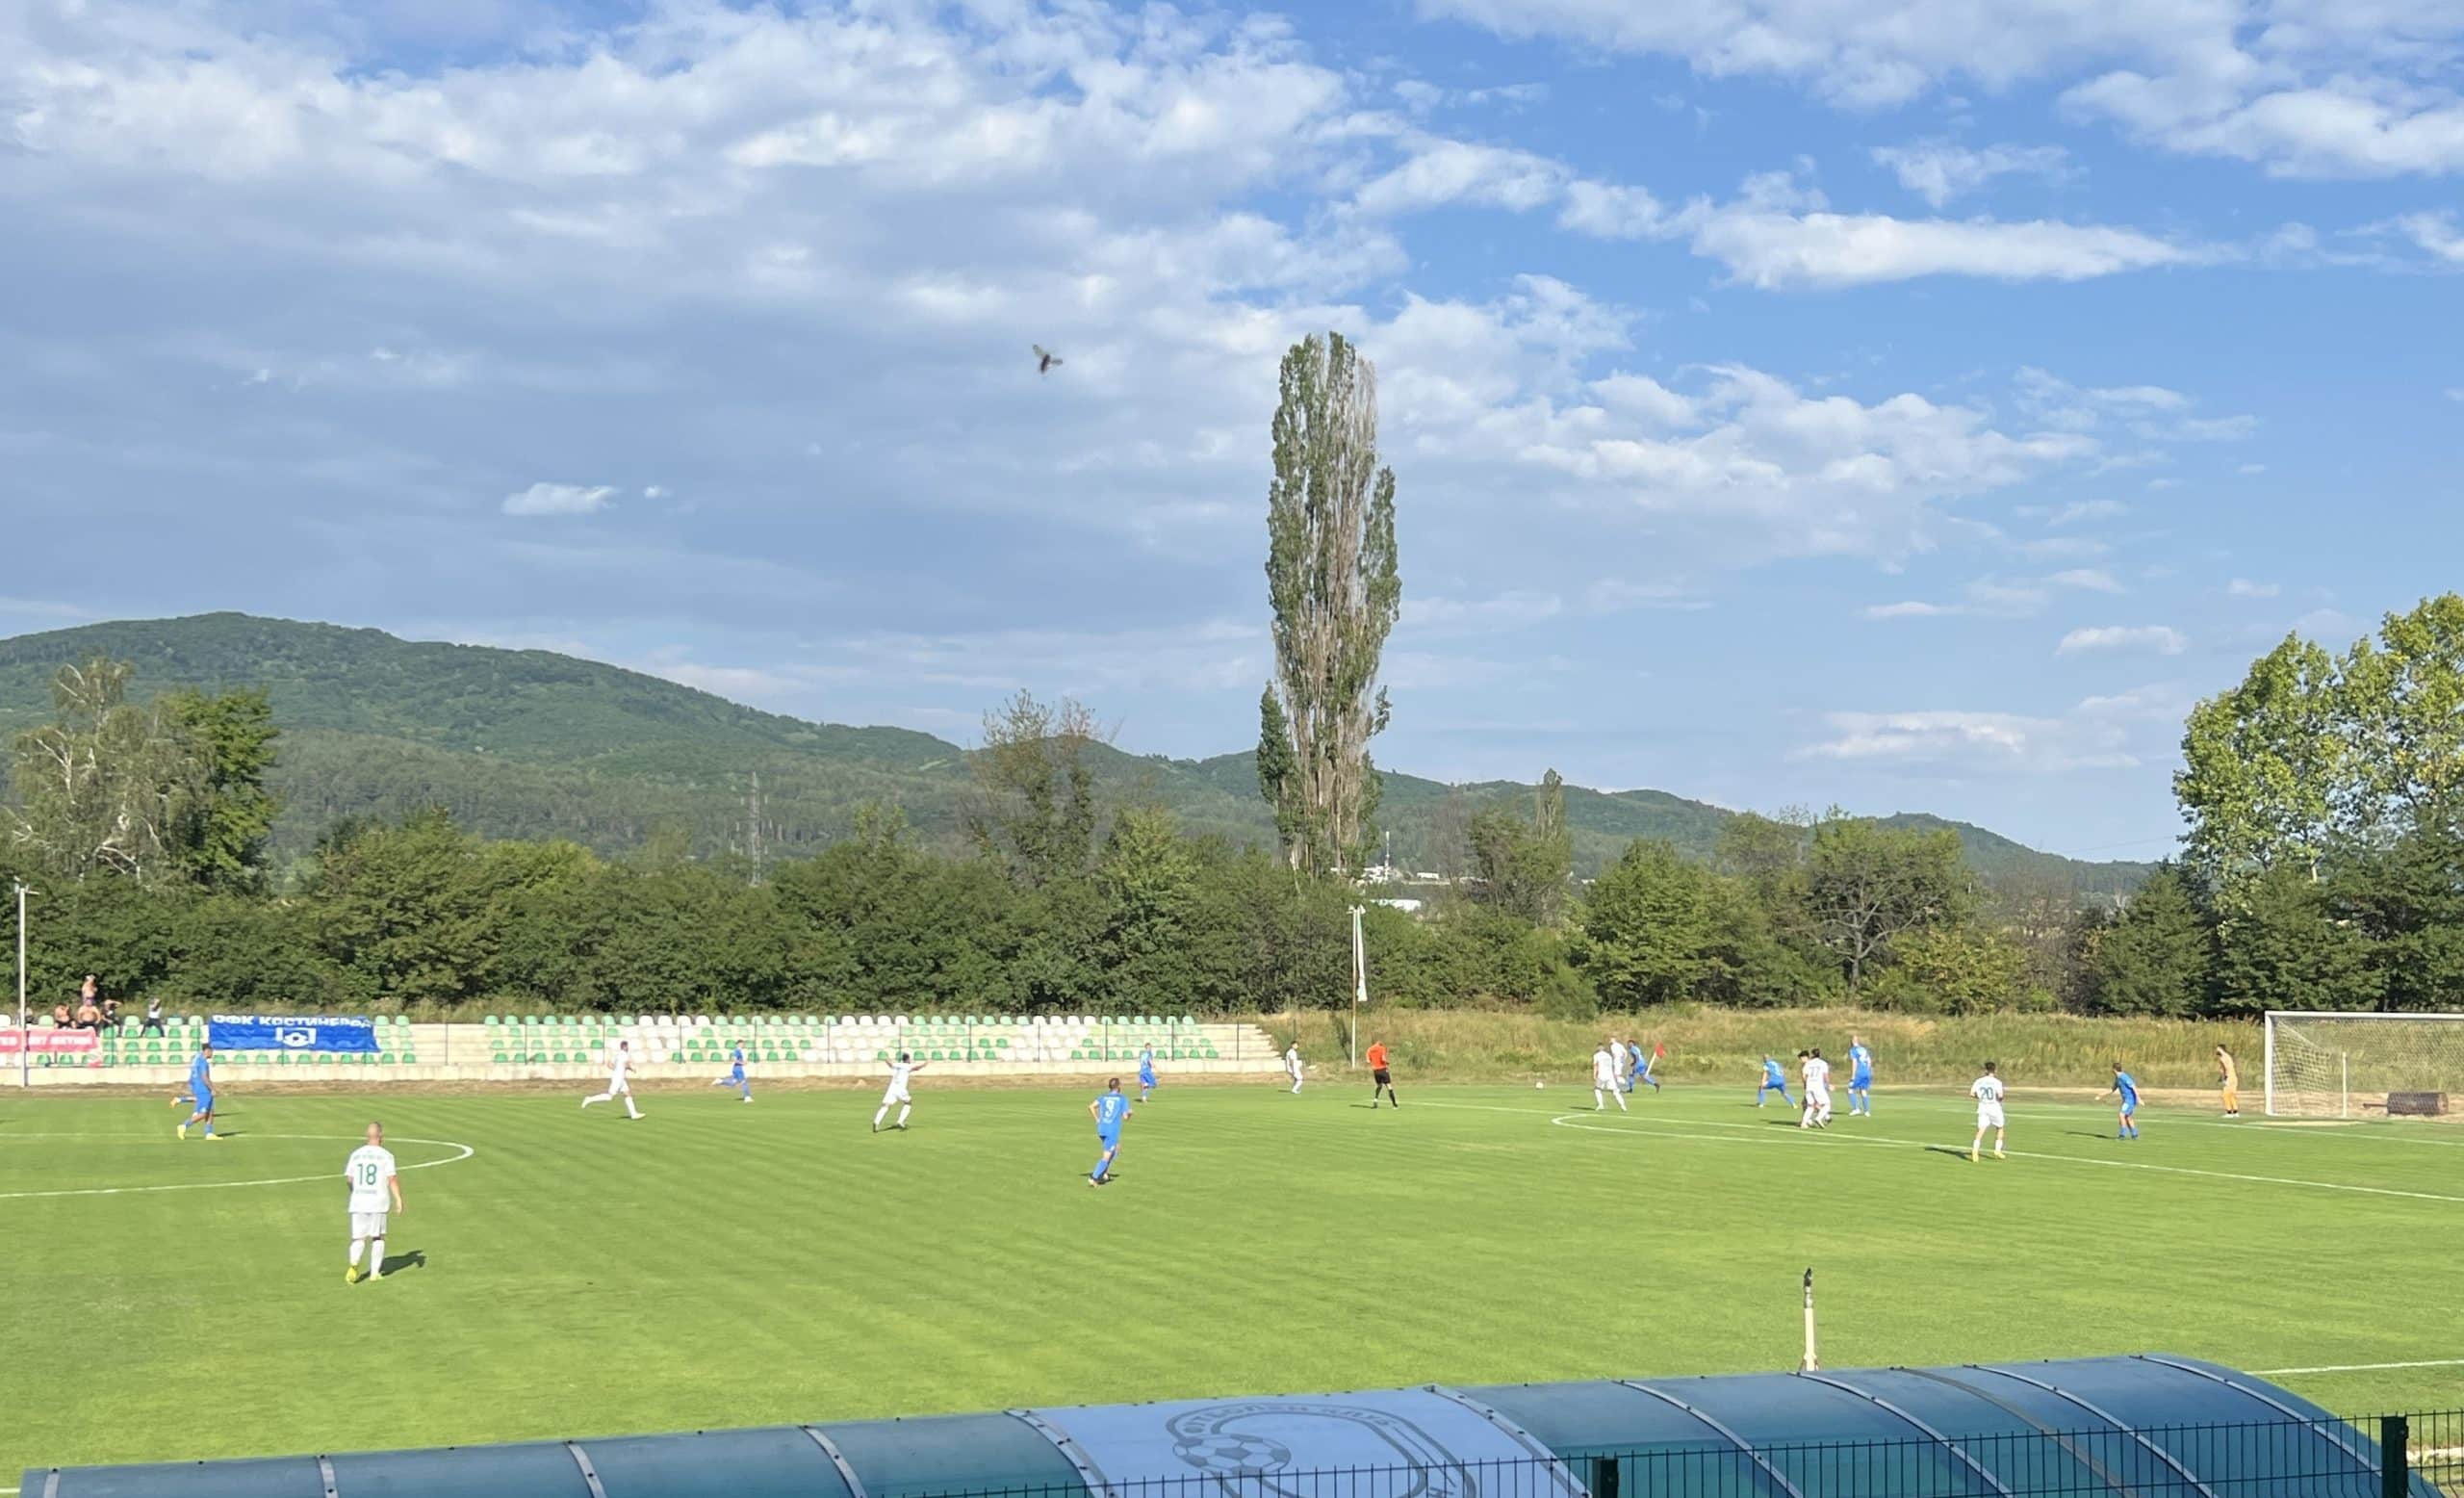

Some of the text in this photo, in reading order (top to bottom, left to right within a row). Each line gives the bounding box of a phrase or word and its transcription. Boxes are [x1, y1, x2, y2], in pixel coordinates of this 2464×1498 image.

[212, 1015, 254, 1025] ОФК
[1979, 1087, 1993, 1100] 20
[1105, 1099, 1115, 1117] 9
[357, 1163, 377, 1185] 18
